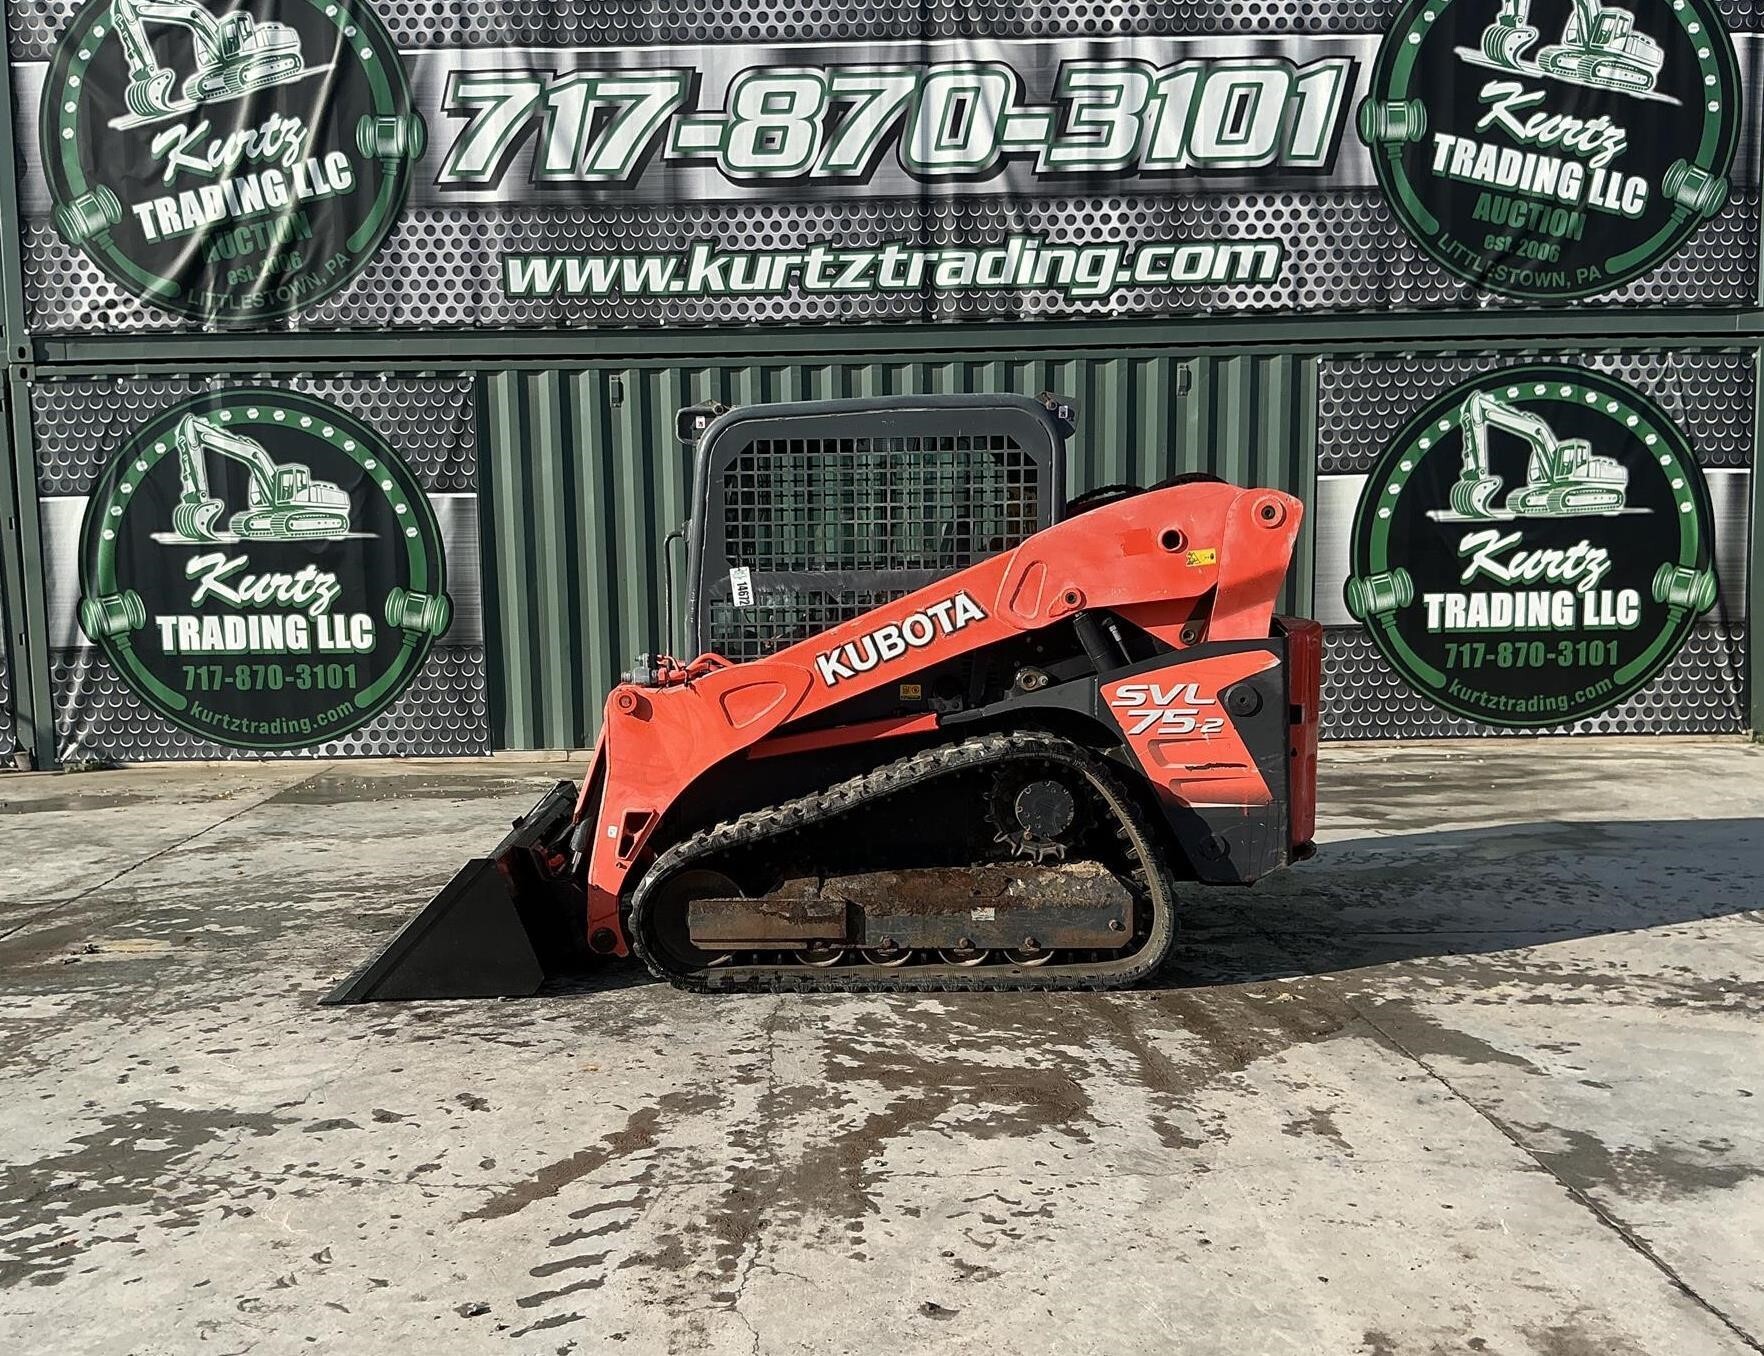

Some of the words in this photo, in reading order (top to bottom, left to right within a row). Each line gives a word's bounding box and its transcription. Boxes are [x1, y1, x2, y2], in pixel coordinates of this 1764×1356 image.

[436, 60, 1357, 185] 717-870-3101
[1476, 80, 1627, 168] Kurtz
[152, 113, 308, 183] Kurtz
[132, 169, 288, 240] TRADING
[291, 150, 353, 198] LLC
[1432, 133, 1583, 206] TRADING
[1586, 168, 1649, 216] LLC
[1471, 192, 1586, 241] AUCTION
[203, 212, 313, 264] AUCTION
[1516, 238, 1561, 263] 2006
[324, 252, 350, 276] PA
[506, 240, 1282, 298] www.kurtztrading.com
[1576, 265, 1602, 285] PA
[1459, 529, 1611, 593] Kurtz
[185, 552, 340, 616] Kurtz
[736, 581, 751, 606] 14672
[1423, 592, 1576, 631] TRADING
[1580, 589, 1641, 628] LLC
[156, 614, 308, 654] TRADING
[315, 612, 376, 652] LLC
[815, 591, 986, 686] KUBOTA
[1445, 640, 1619, 669] 717-870-3101
[183, 664, 357, 691] 717-870-3101
[1111, 682, 1216, 707] SVL
[1449, 679, 1613, 712] kurtztrading.com
[190, 701, 354, 735] kurtztrading.com
[1126, 708, 1225, 735] 75-2
